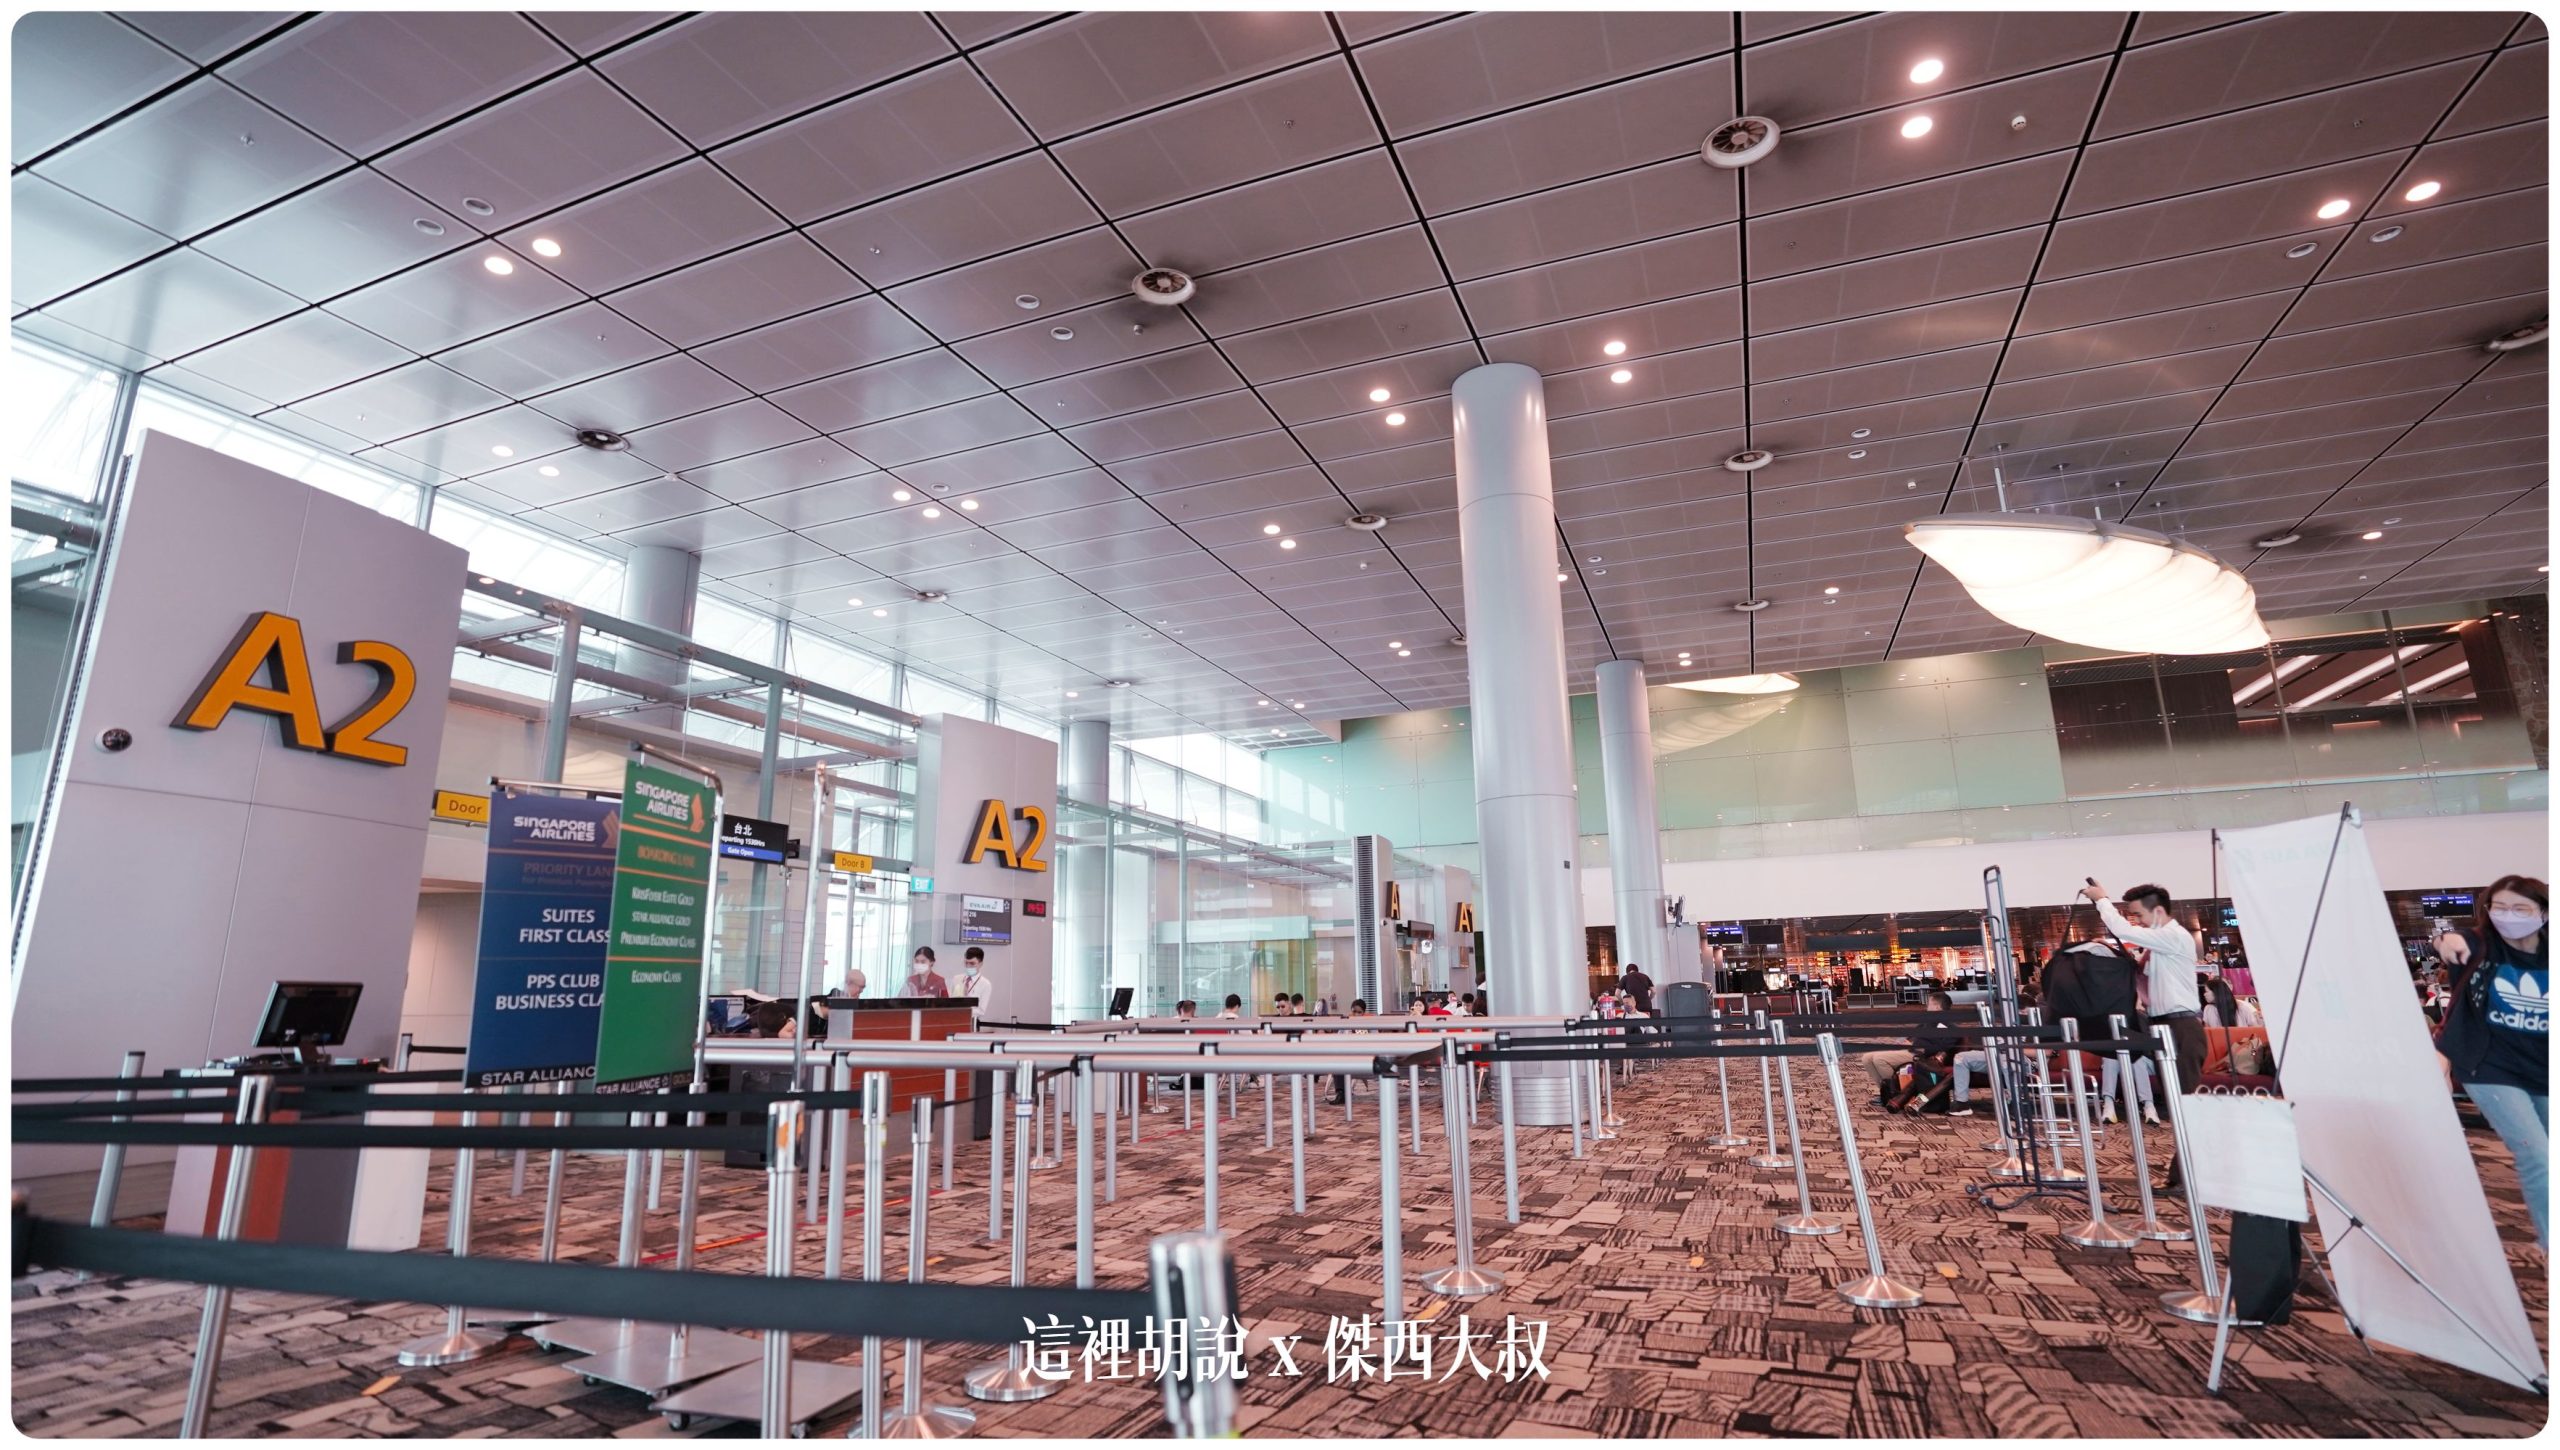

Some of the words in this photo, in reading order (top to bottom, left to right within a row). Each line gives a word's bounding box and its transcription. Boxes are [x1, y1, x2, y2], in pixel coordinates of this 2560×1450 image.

[169, 611, 417, 767] A2
[635, 781, 690, 808] SINGAPORE
[449, 799, 482, 815] Door
[646, 800, 688, 821] AIRLINES
[514, 816, 596, 832] SINGAPORE
[734, 822, 752, 836] 台北
[530, 828, 595, 842] AIRLINES
[721, 836, 744, 845] eparting
[962, 799, 1047, 872] A2
[523, 862, 583, 876] PRIORITY
[586, 865, 613, 877] LAN
[841, 857, 858, 868] Door
[542, 908, 595, 923] SUITES
[519, 928, 562, 943] FIRST
[527, 974, 556, 989] PPS
[560, 973, 600, 988] CLUB
[496, 993, 575, 1010] BUSINESS
[2489, 1010, 2549, 1031] adida
[481, 1071, 524, 1086] STAR
[620, 1076, 660, 1094] ALLIANCE
